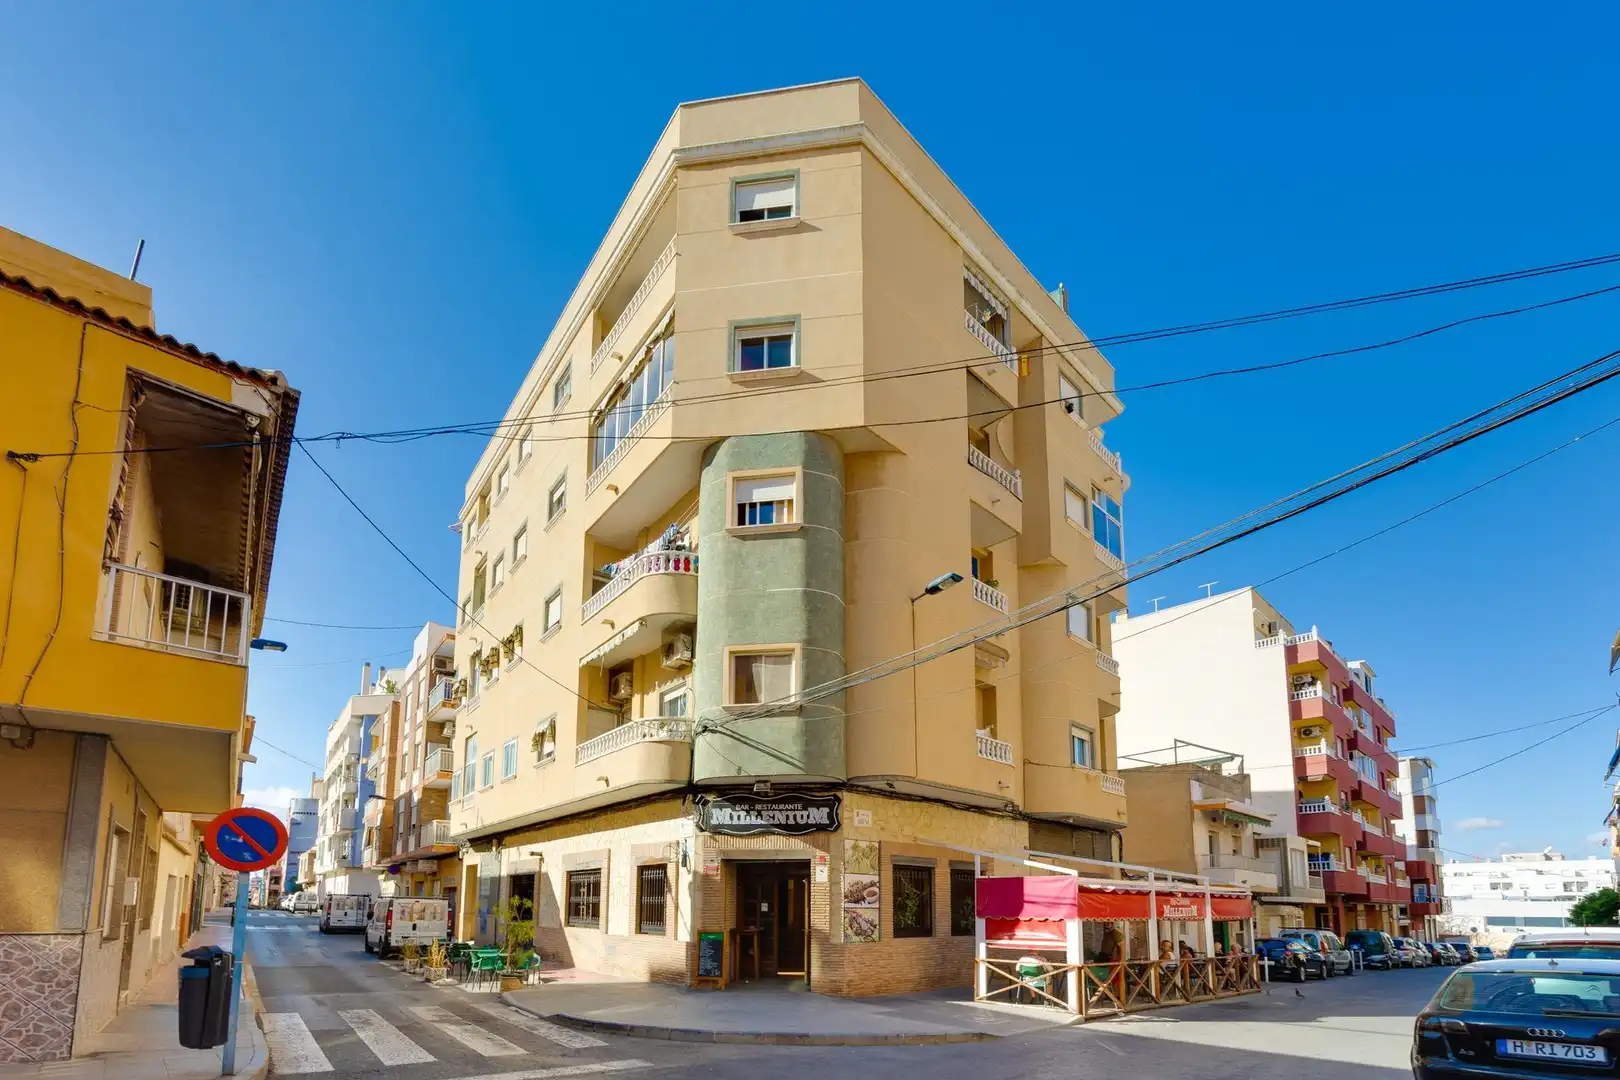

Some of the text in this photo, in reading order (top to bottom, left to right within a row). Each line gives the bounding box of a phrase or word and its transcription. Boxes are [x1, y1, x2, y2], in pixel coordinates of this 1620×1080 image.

[711, 807, 830, 825] MILLENIUM
[755, 803, 803, 811] RESTAURANTE
[1513, 1041, 1524, 1053] H
[1561, 1045, 1597, 1059] 703
